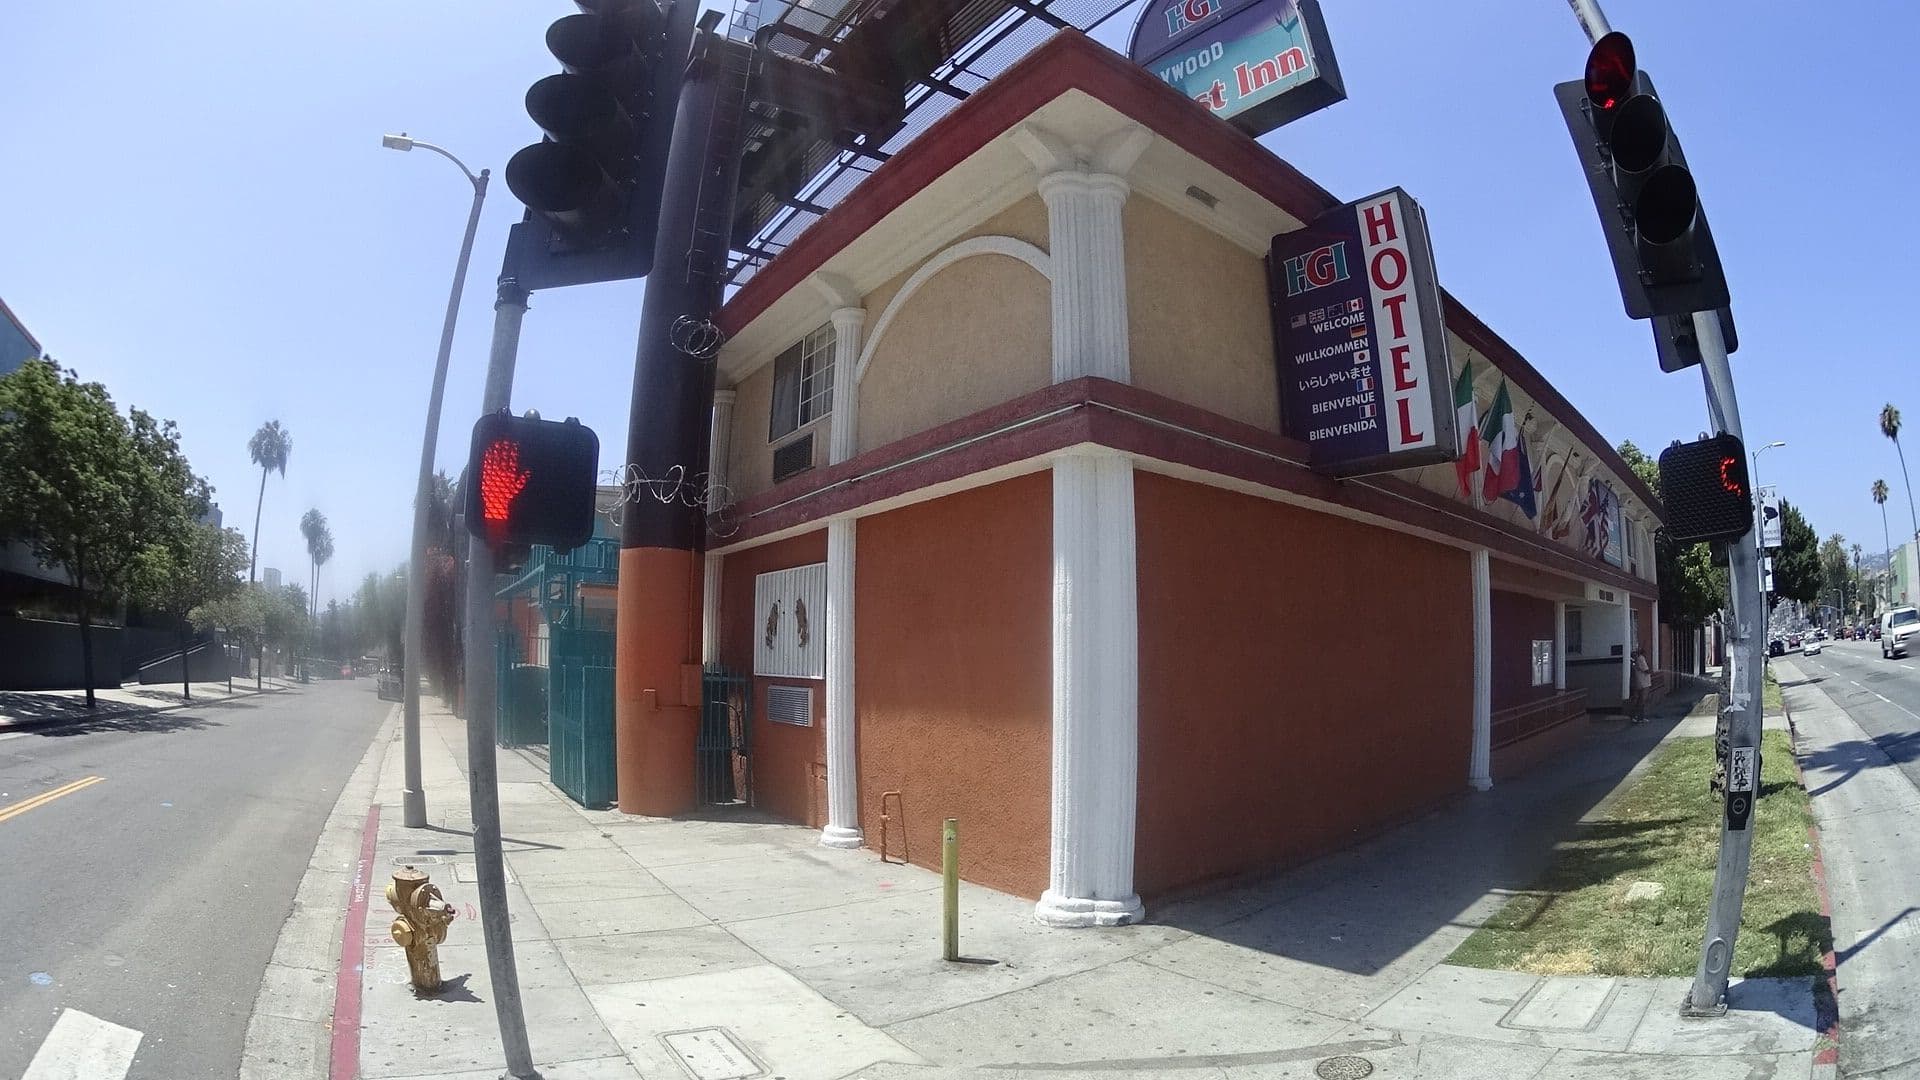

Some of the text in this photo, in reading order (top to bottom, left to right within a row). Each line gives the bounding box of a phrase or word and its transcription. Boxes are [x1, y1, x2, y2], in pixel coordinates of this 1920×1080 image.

[1233, 46, 1308, 99] Inn
[1283, 241, 1350, 297] HGI
[1313, 312, 1366, 334] WELCOME
[1363, 201, 1424, 445] HOTEL
[1295, 337, 1369, 364] WILLKOMMEN
[1312, 391, 1375, 414] BIENVENUE
[1309, 419, 1377, 441] BIENVENIDA
